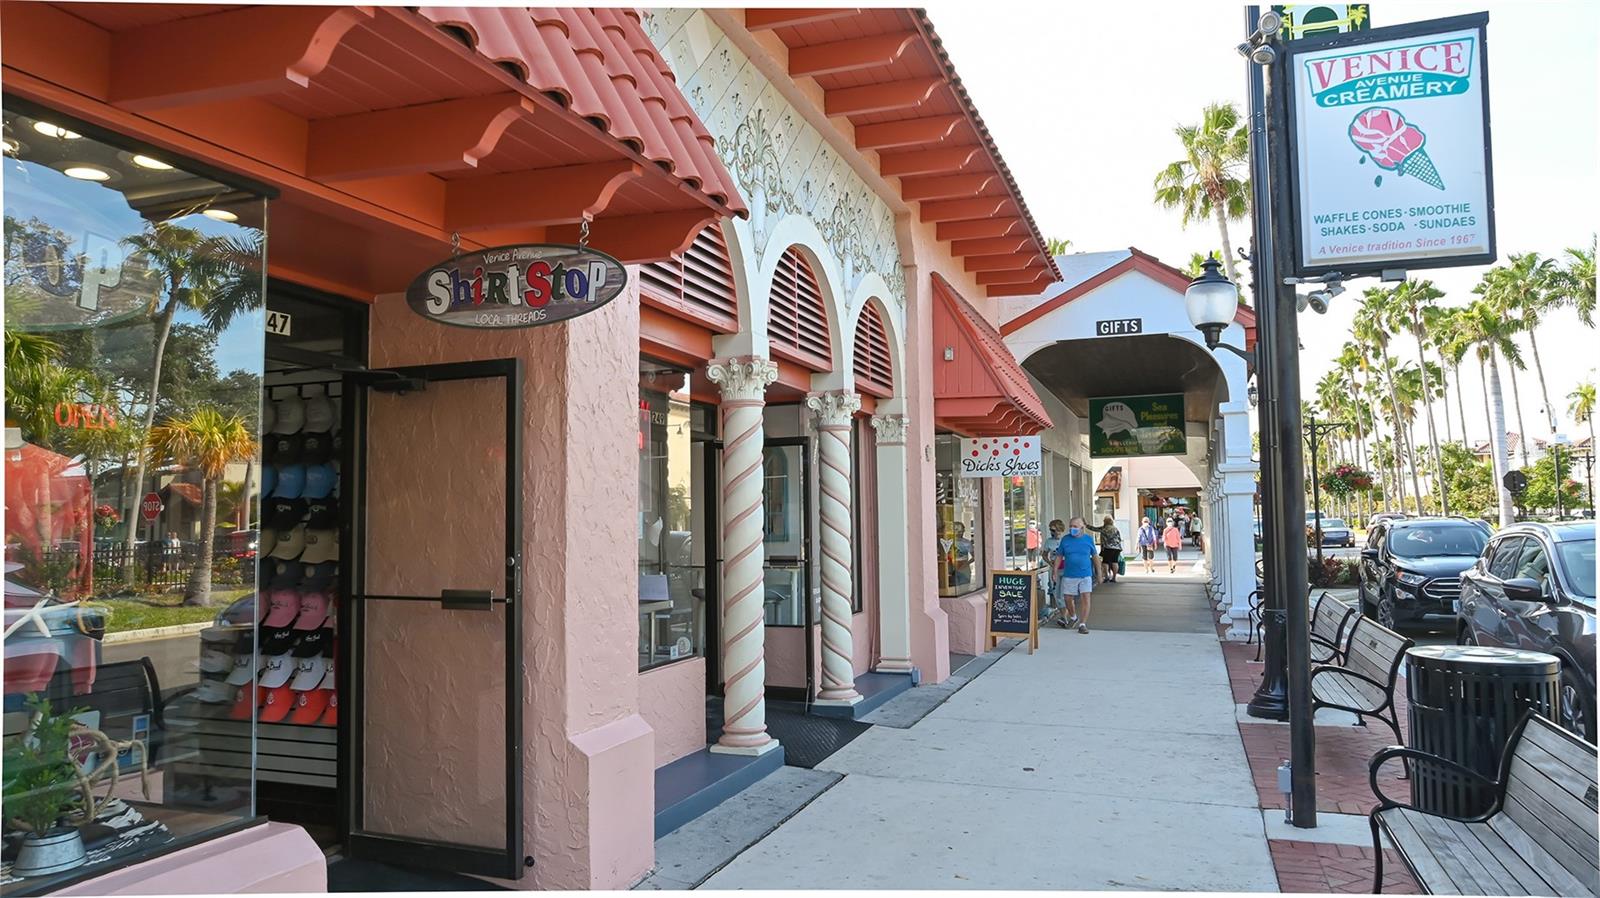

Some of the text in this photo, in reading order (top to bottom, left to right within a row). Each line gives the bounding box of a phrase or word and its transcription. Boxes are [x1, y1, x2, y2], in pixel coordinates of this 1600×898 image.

[1312, 42, 1465, 89] VENICE
[1355, 74, 1423, 89] AVENUE
[1323, 81, 1457, 106] CREAMERY
[1313, 211, 1359, 225] WAFFLE
[1409, 203, 1471, 217] SMOOTHIE
[1320, 216, 1476, 237] SHAKES SODA SUNDAES
[1319, 234, 1476, 255] A Venice tradition Since 1967
[483, 248, 544, 265] Venice Avenue
[475, 309, 547, 325] LOCAL THREADS
[1100, 320, 1138, 334] GIFTS
[1105, 403, 1124, 412] GIFTS
[963, 456, 1040, 476] Dick's Shoes
[999, 576, 1025, 585] HUGE
[999, 590, 1023, 598] SALE
